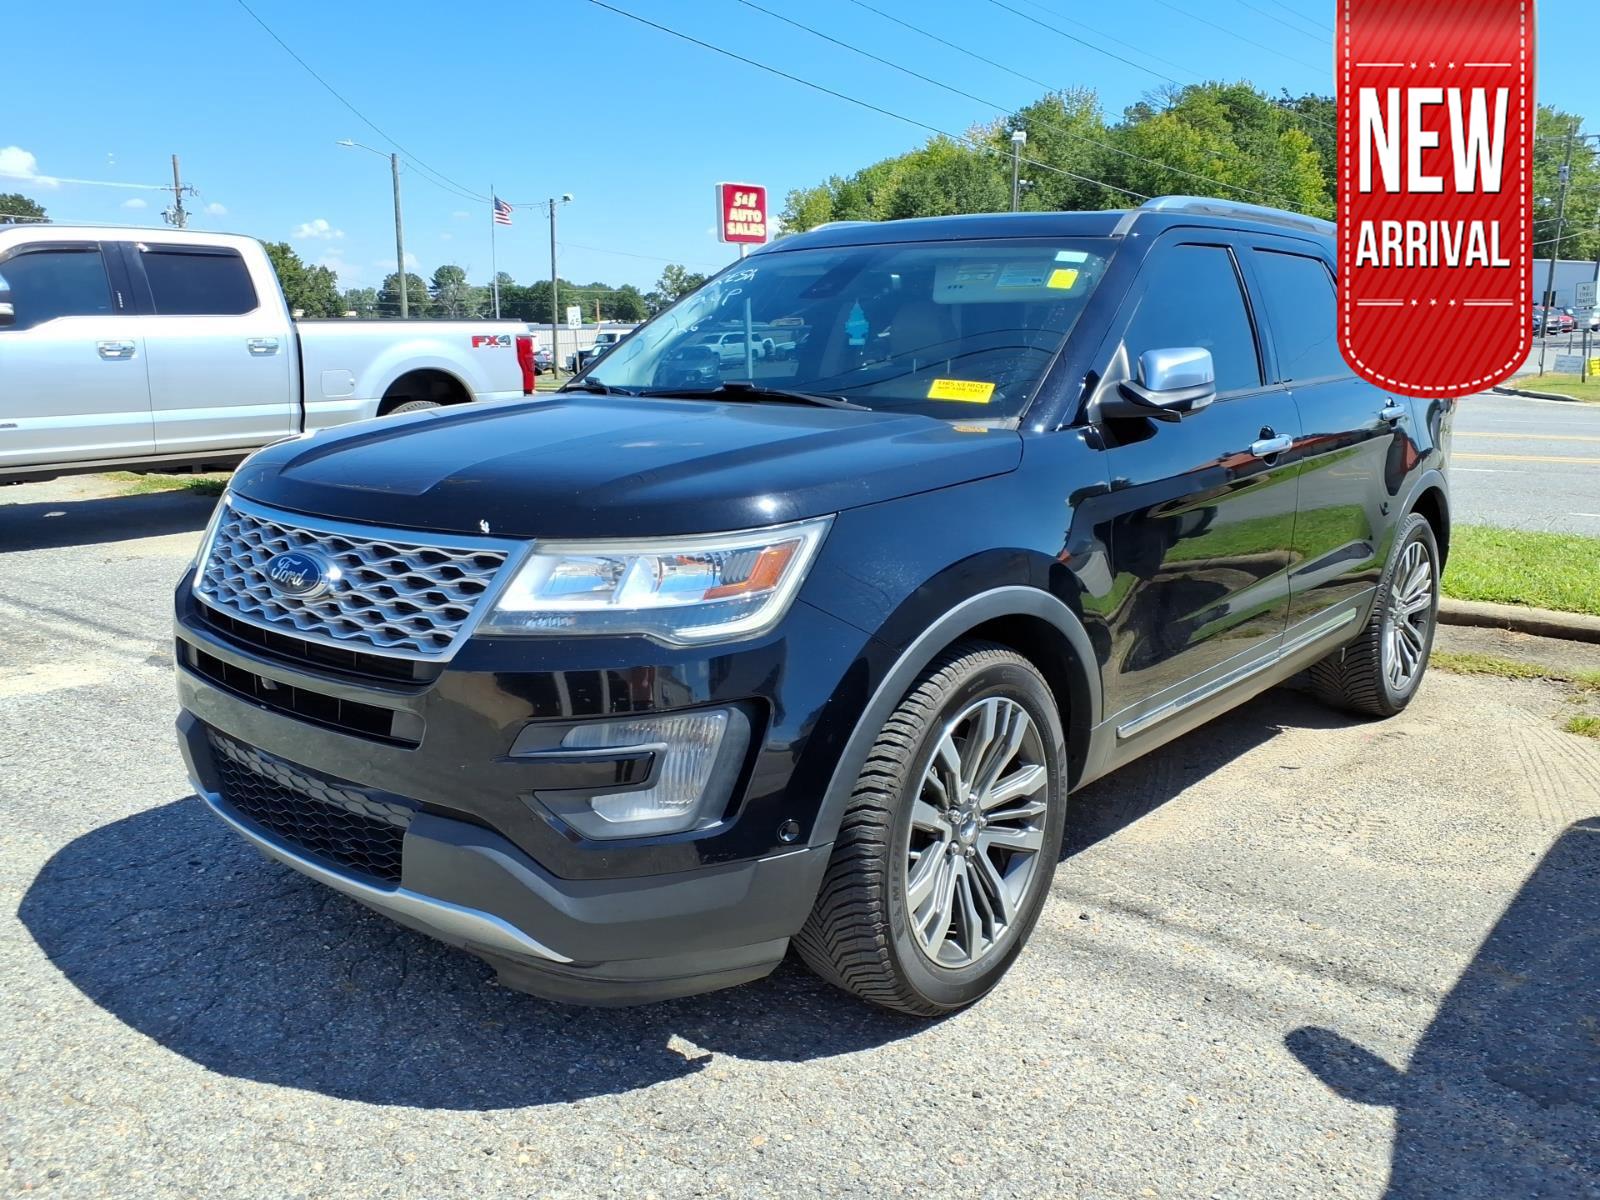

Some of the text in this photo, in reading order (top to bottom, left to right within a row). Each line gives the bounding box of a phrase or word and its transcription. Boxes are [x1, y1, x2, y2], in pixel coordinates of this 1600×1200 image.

[729, 208, 762, 223] AUTO
[726, 222, 765, 237] SALES
[472, 335, 511, 348] FX4
[271, 556, 309, 587] Ford
